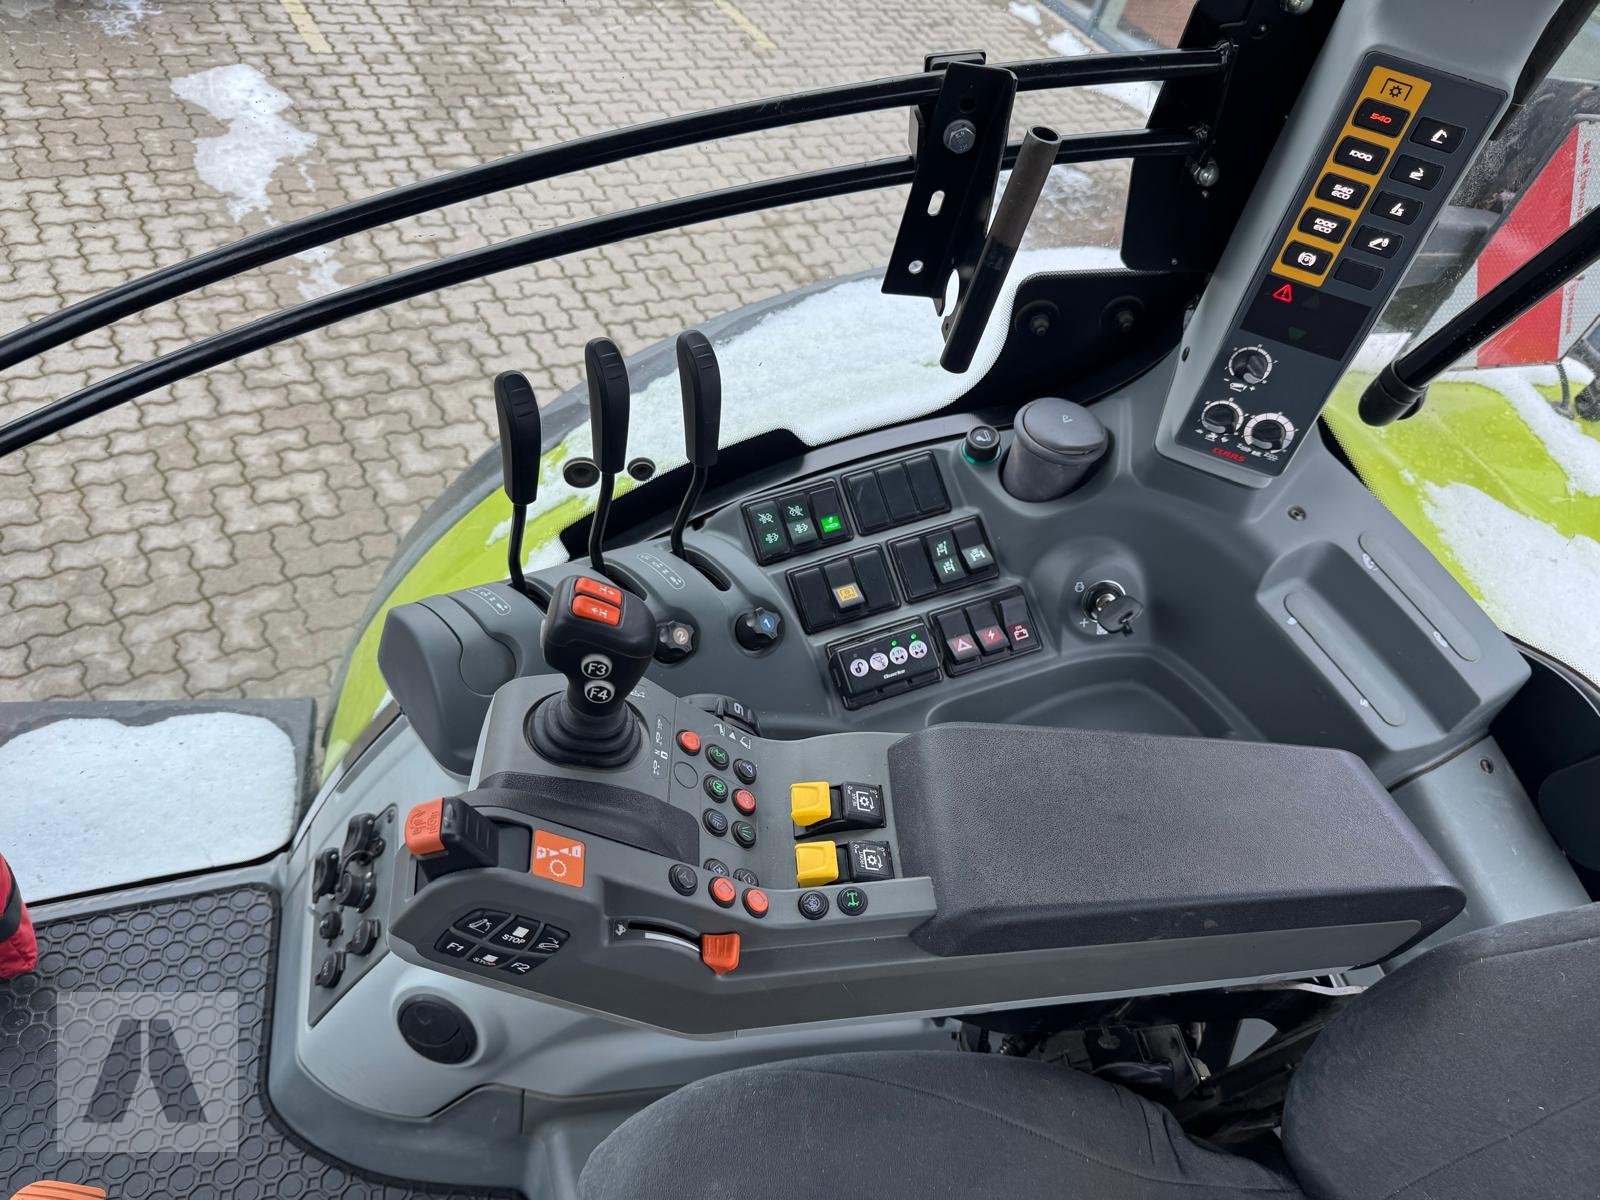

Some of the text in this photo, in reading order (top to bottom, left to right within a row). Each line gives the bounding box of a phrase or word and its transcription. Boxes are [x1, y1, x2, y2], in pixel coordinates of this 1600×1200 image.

[1369, 112, 1393, 125] 540
[1349, 149, 1373, 162] 1000
[1332, 183, 1354, 195] 540
[1314, 217, 1338, 229] 1000
[762, 618, 771, 628] 1
[677, 630, 686, 641] 2
[587, 662, 607, 676] F3
[589, 687, 608, 700] F4
[502, 933, 526, 945] STOP
[446, 942, 465, 952] F1
[472, 956, 496, 966] STOP
[510, 961, 531, 973] F2
